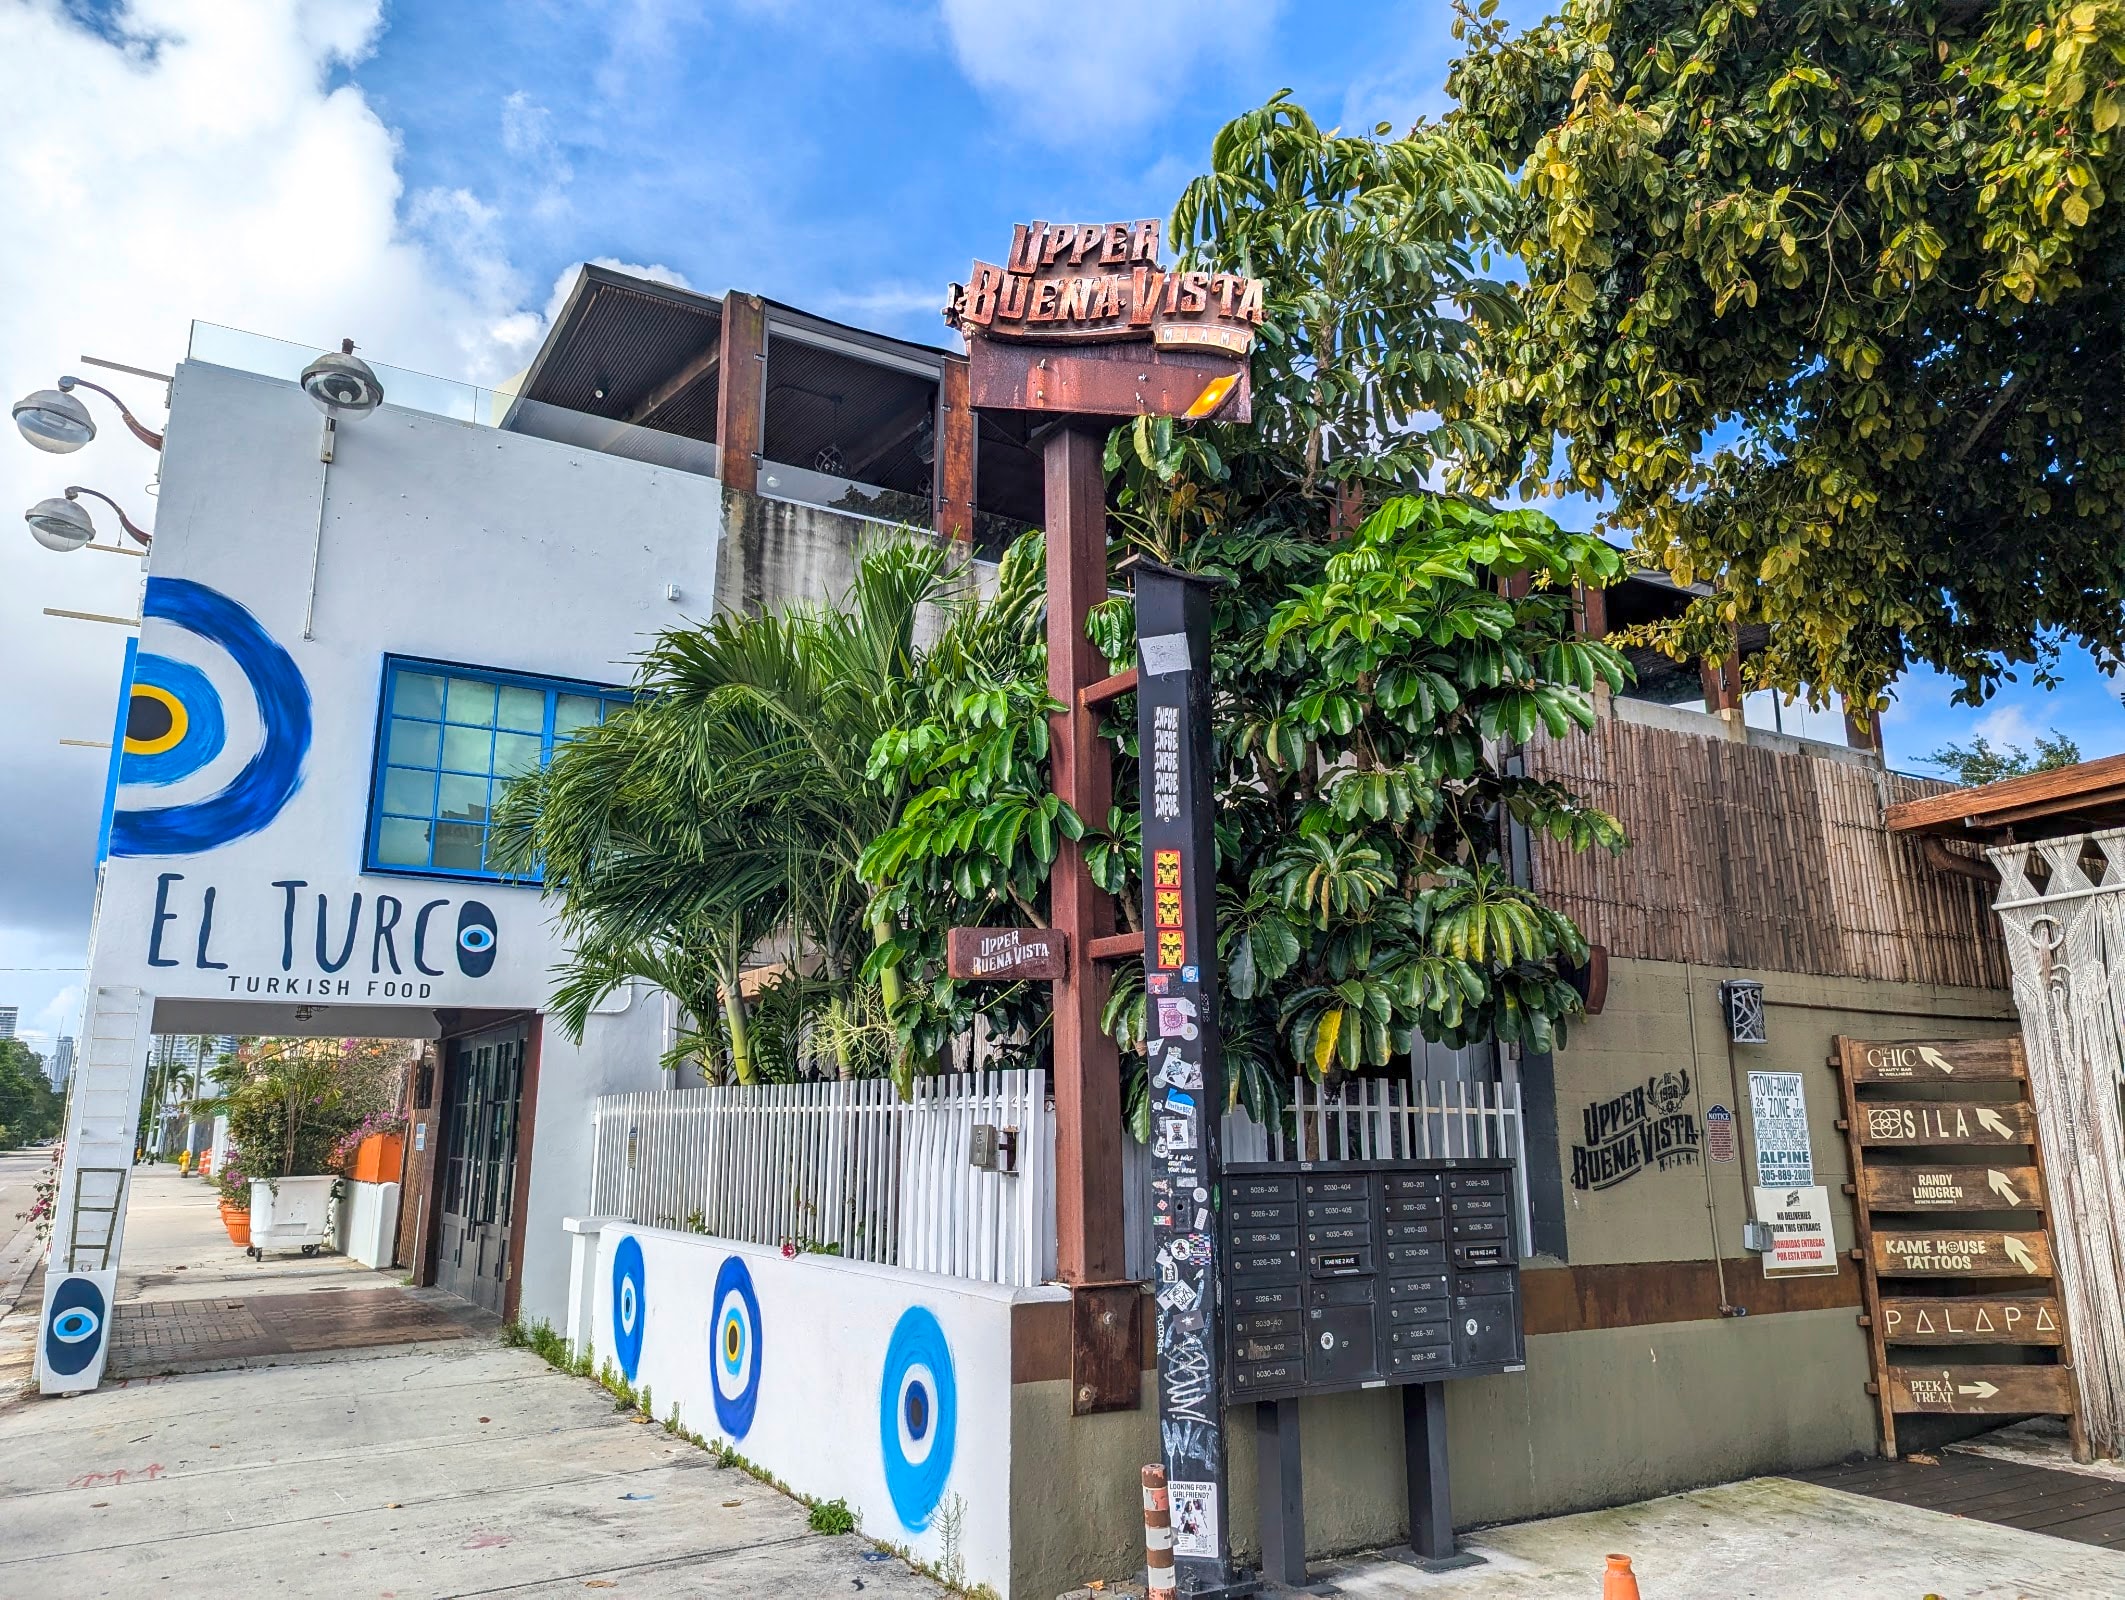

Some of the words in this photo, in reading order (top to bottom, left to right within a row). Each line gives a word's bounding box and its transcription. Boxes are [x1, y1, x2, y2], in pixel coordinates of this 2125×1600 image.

[1007, 219, 1163, 275] UPPER
[955, 259, 1128, 328] BUENA
[1128, 266, 1267, 328] VISTA
[147, 873, 229, 969] EL
[270, 880, 498, 978] TURCO
[981, 930, 1021, 957] UPPER
[971, 951, 1013, 976] BUENA
[1013, 943, 1050, 966] VISTA
[227, 975, 350, 996] TURKISH
[367, 980, 432, 999] FOOD
[1867, 1048, 1917, 1068] CHIC
[1753, 1075, 1799, 1097] TOW-AWAY
[1755, 1096, 1764, 1107] 24
[1768, 1097, 1792, 1118] ZONE
[1795, 1097, 1799, 1108] 7
[1583, 1086, 1651, 1146] UPPER
[1708, 1112, 1730, 1120] NOTICE
[1903, 1108, 1970, 1139] SILA
[1570, 1134, 1641, 1190] BUENA
[1638, 1114, 1700, 1166] VISTA
[1760, 1151, 1810, 1163] ALPINE
[1918, 1174, 1953, 1186] RANDY
[1250, 1185, 1279, 1194] 5026-306
[1323, 1183, 1352, 1191] 5030-404
[1912, 1186, 1963, 1199] LINDGREN
[1250, 1209, 1280, 1218] 5026-307
[1324, 1206, 1353, 1214] 5030-405
[1776, 1211, 1785, 1220] NO
[1785, 1211, 1812, 1220] DELIVERIES
[1772, 1223, 1785, 1233] ROM
[1784, 1223, 1797, 1233] THIS
[1797, 1222, 1822, 1232] ENTRANCE
[1773, 1239, 1801, 1249] ROHIBIDAS
[1801, 1238, 1826, 1248] ENTREGAS
[1885, 1240, 1931, 1254] KAME
[1936, 1240, 1988, 1254] HOUSE
[1776, 1252, 1787, 1261] POR
[1788, 1251, 1800, 1261] ESTA
[1800, 1250, 1823, 1260] ENTRADA
[1903, 1255, 1972, 1270] TATTOOS
[1885, 1306, 2056, 1334] PALAPA
[1911, 1380, 1942, 1392] PEEK
[1913, 1391, 1954, 1403] TREAT
[1169, 1483, 1195, 1491] LOOKING
[1172, 1491, 1210, 1499] GIRLFRIEND?
